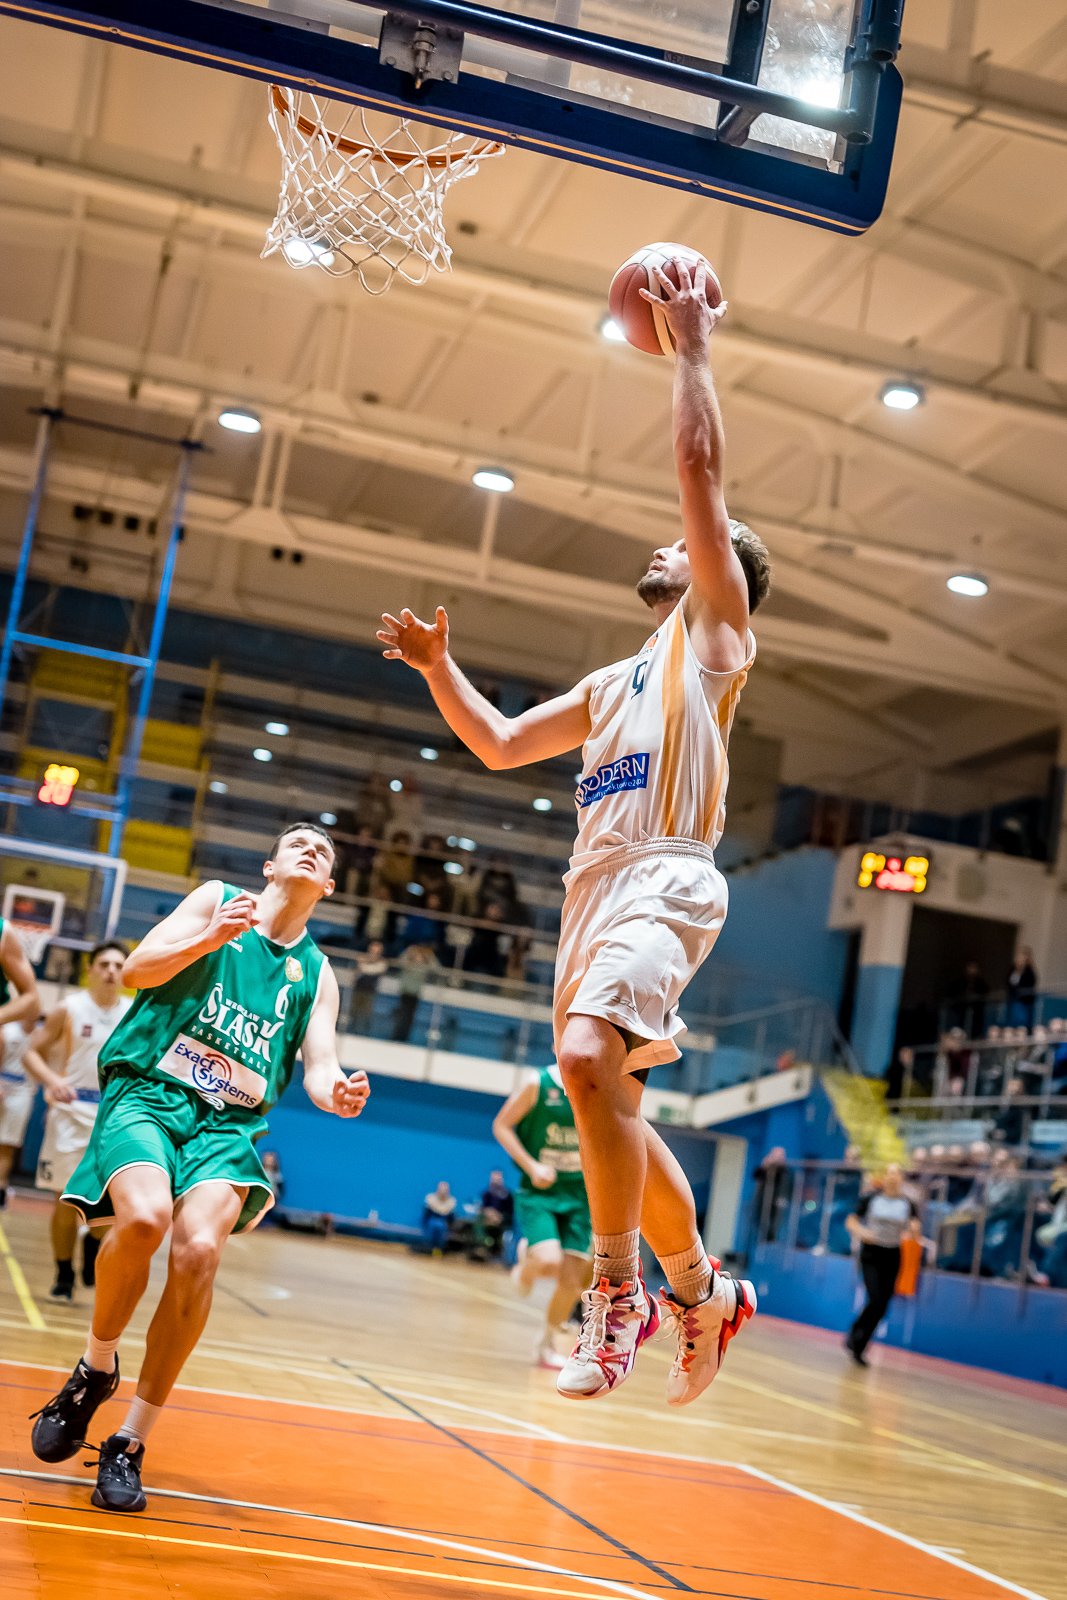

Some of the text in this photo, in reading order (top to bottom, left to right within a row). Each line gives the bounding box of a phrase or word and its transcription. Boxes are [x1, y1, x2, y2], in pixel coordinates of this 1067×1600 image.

[174, 1042, 216, 1071] Exact
[191, 1025, 267, 1074] BASKETBALL
[198, 1067, 257, 1106] Systems
